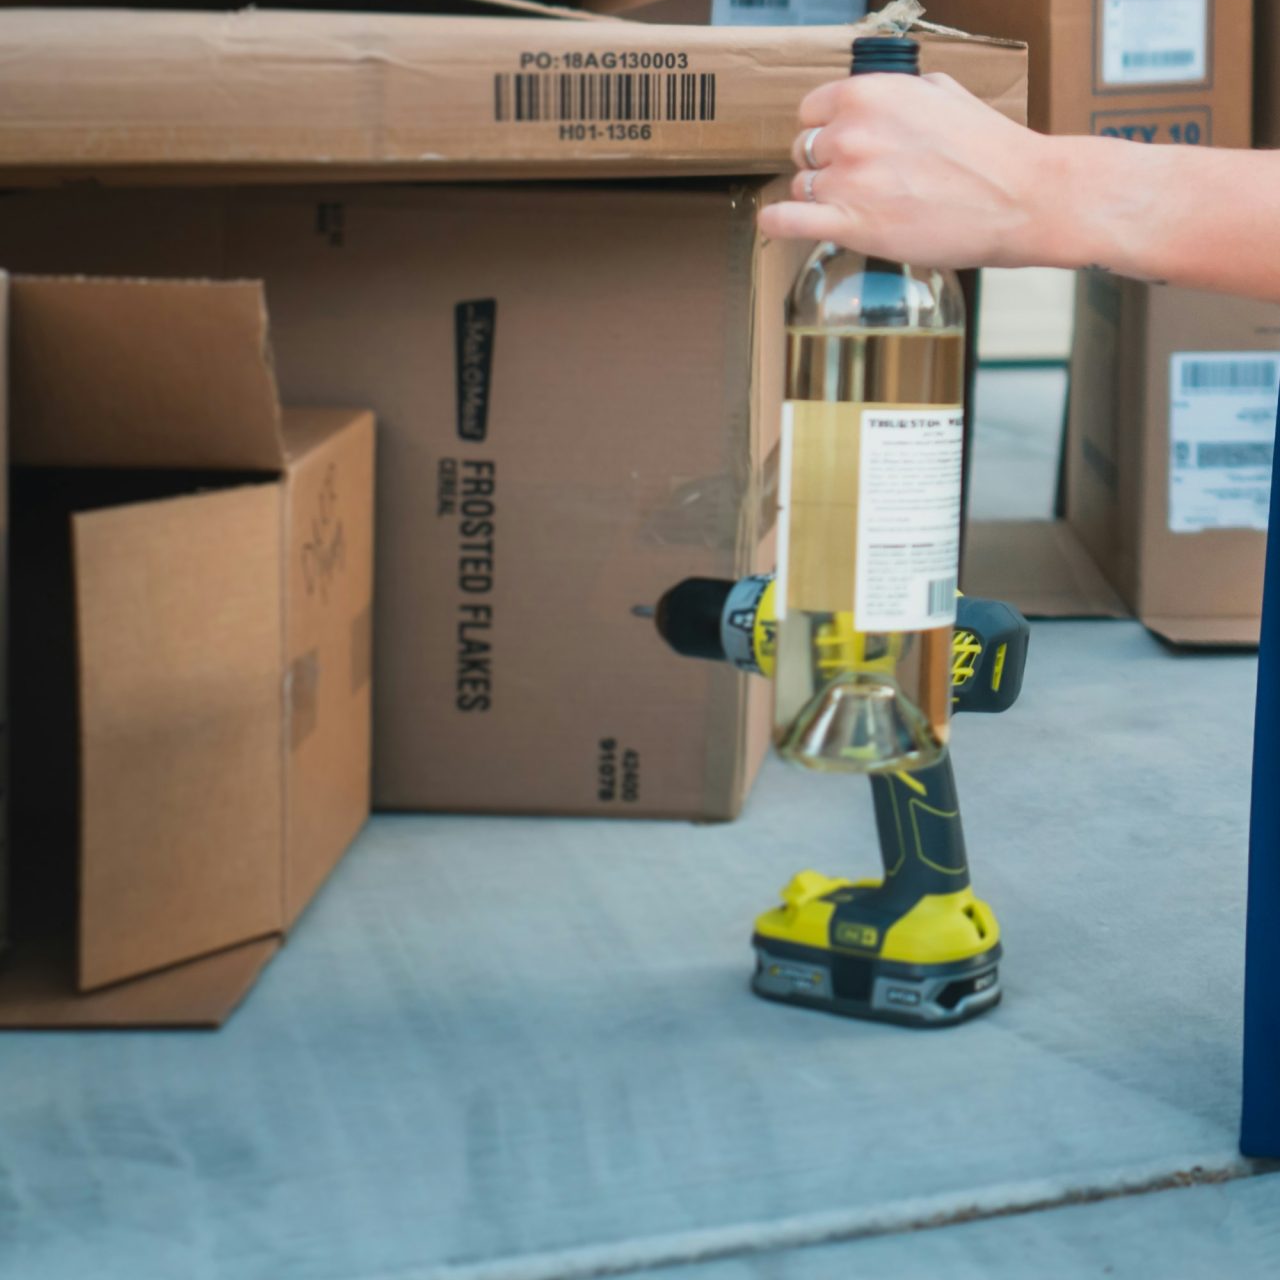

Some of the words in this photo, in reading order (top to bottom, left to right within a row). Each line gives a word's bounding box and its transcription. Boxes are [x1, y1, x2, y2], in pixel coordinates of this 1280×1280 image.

[520, 52, 689, 70] PO:18AG130003
[558, 124, 652, 141] H01-1366
[437, 458, 457, 517] CEREAL
[457, 460, 495, 595] FROSTED
[456, 604, 493, 713] FLAKES
